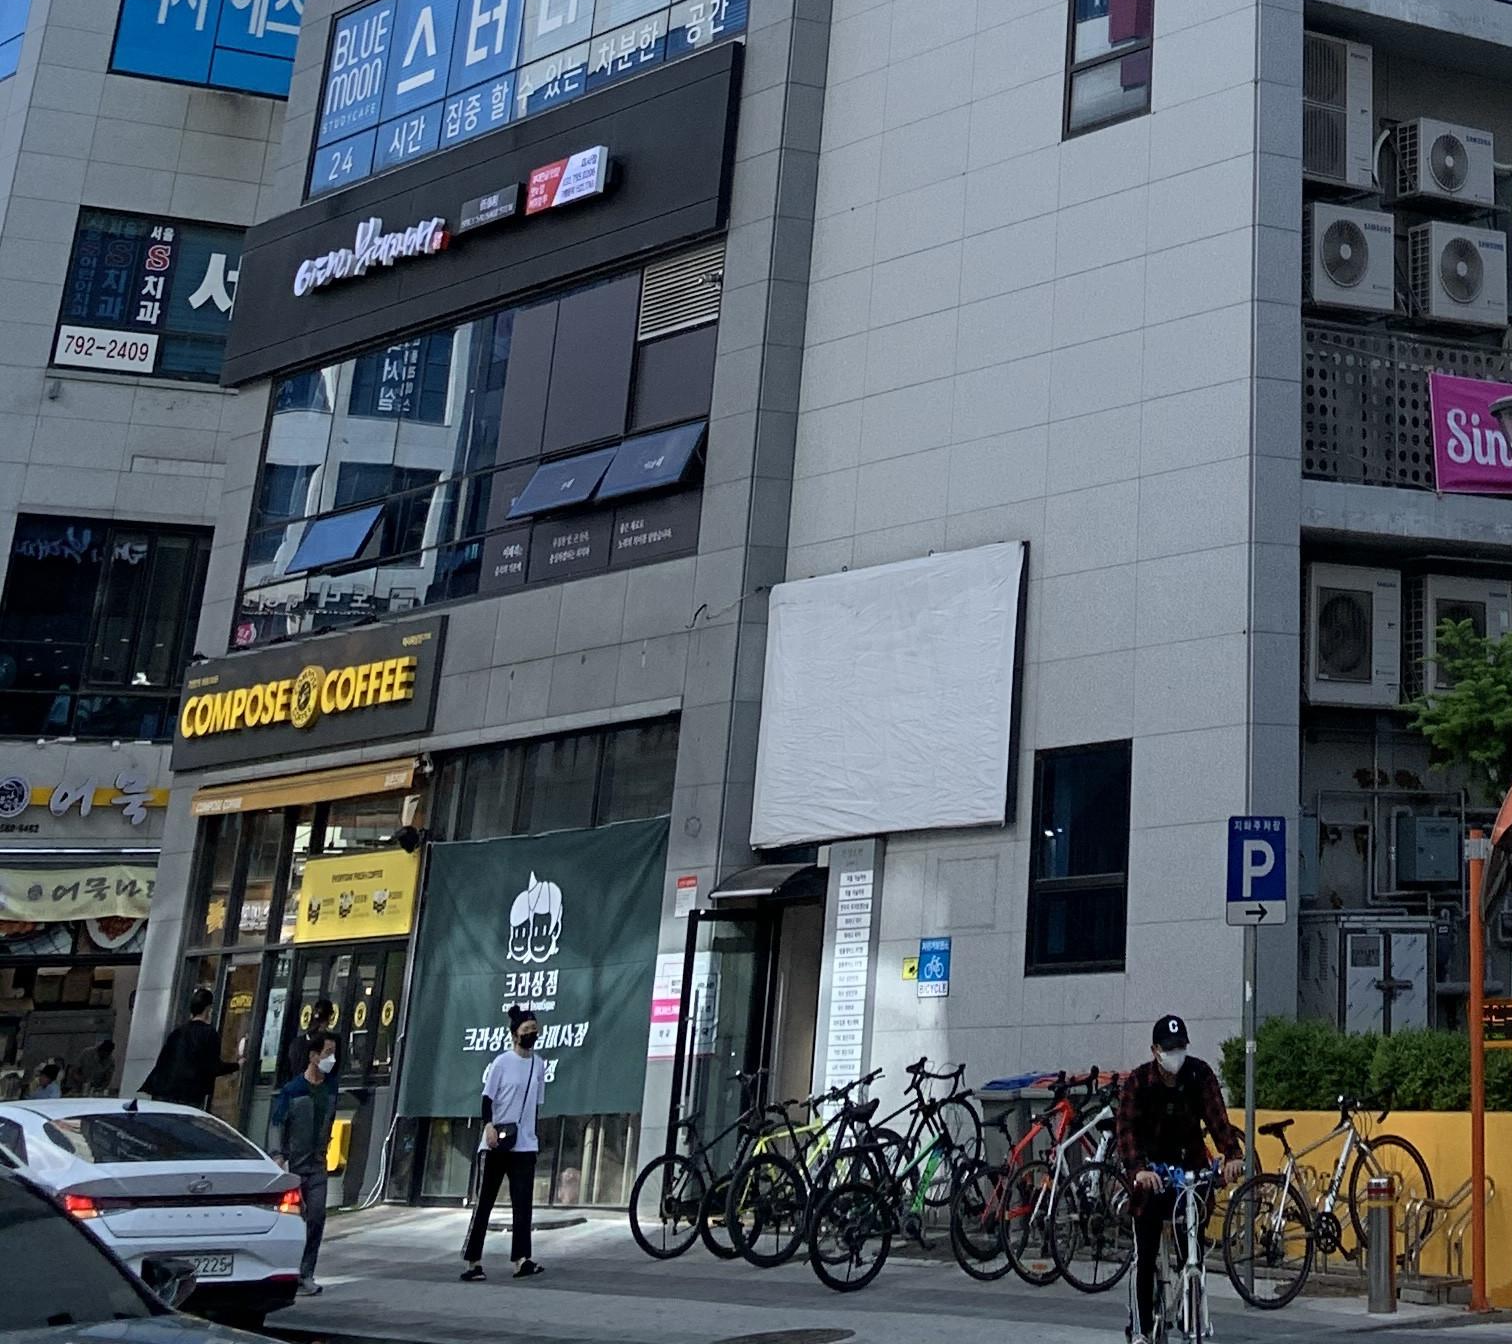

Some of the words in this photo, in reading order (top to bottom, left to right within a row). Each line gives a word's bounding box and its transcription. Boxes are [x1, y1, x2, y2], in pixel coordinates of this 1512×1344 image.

[333, 9, 390, 73] BLUE
[329, 148, 354, 182] 24
[389, 118, 426, 157] 시간
[445, 93, 482, 140] 집중
[491, 80, 509, 121] 할
[517, 82, 535, 116] 수
[544, 55, 583, 101] 있는
[596, 20, 660, 77] 차분한
[150, 225, 175, 242] 서울
[145, 244, 171, 272] S
[136, 275, 165, 326] 치과
[64, 334, 150, 362] 792-2409
[181, 679, 292, 739] COMPOSE
[320, 655, 417, 715] COFFEE
[1242, 839, 1276, 898] P
[503, 969, 560, 998] 크라상점
[919, 983, 947, 994] BICYCLE
